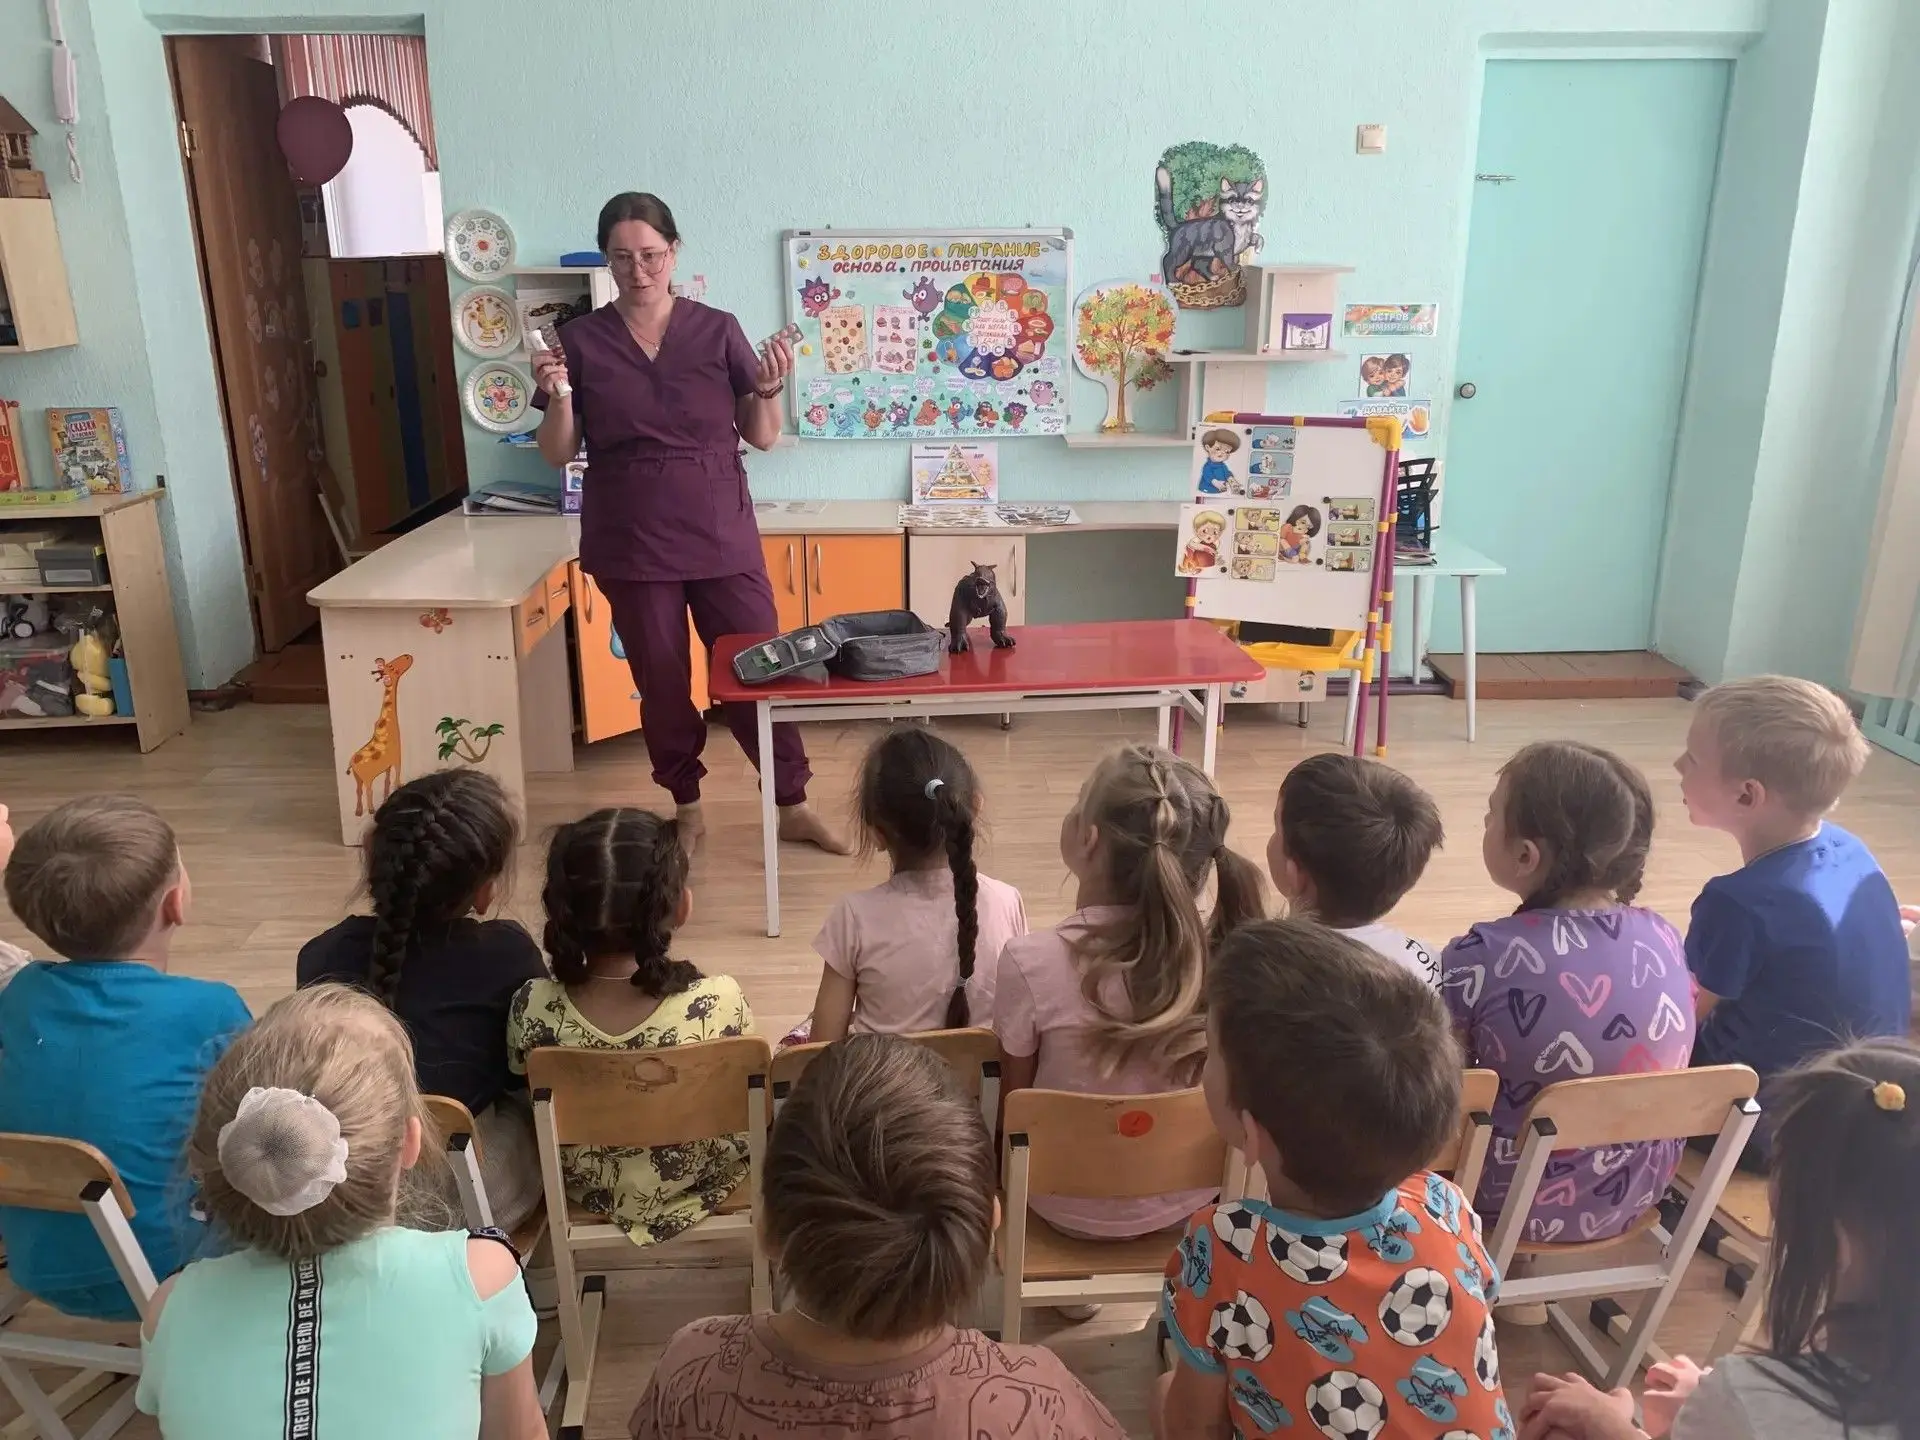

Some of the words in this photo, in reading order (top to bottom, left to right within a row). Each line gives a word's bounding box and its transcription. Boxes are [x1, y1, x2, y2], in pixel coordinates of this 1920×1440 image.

[817, 243, 928, 260] ЗДОРОВОЕ
[1364, 403, 1408, 415] ДАВАЙТЕ
[298, 1287, 315, 1300] IN
[298, 1301, 314, 1319] BE
[296, 1322, 313, 1359] TREND
[295, 1360, 312, 1376] IN
[294, 1378, 311, 1396] BE
[293, 1398, 310, 1439] TREND
